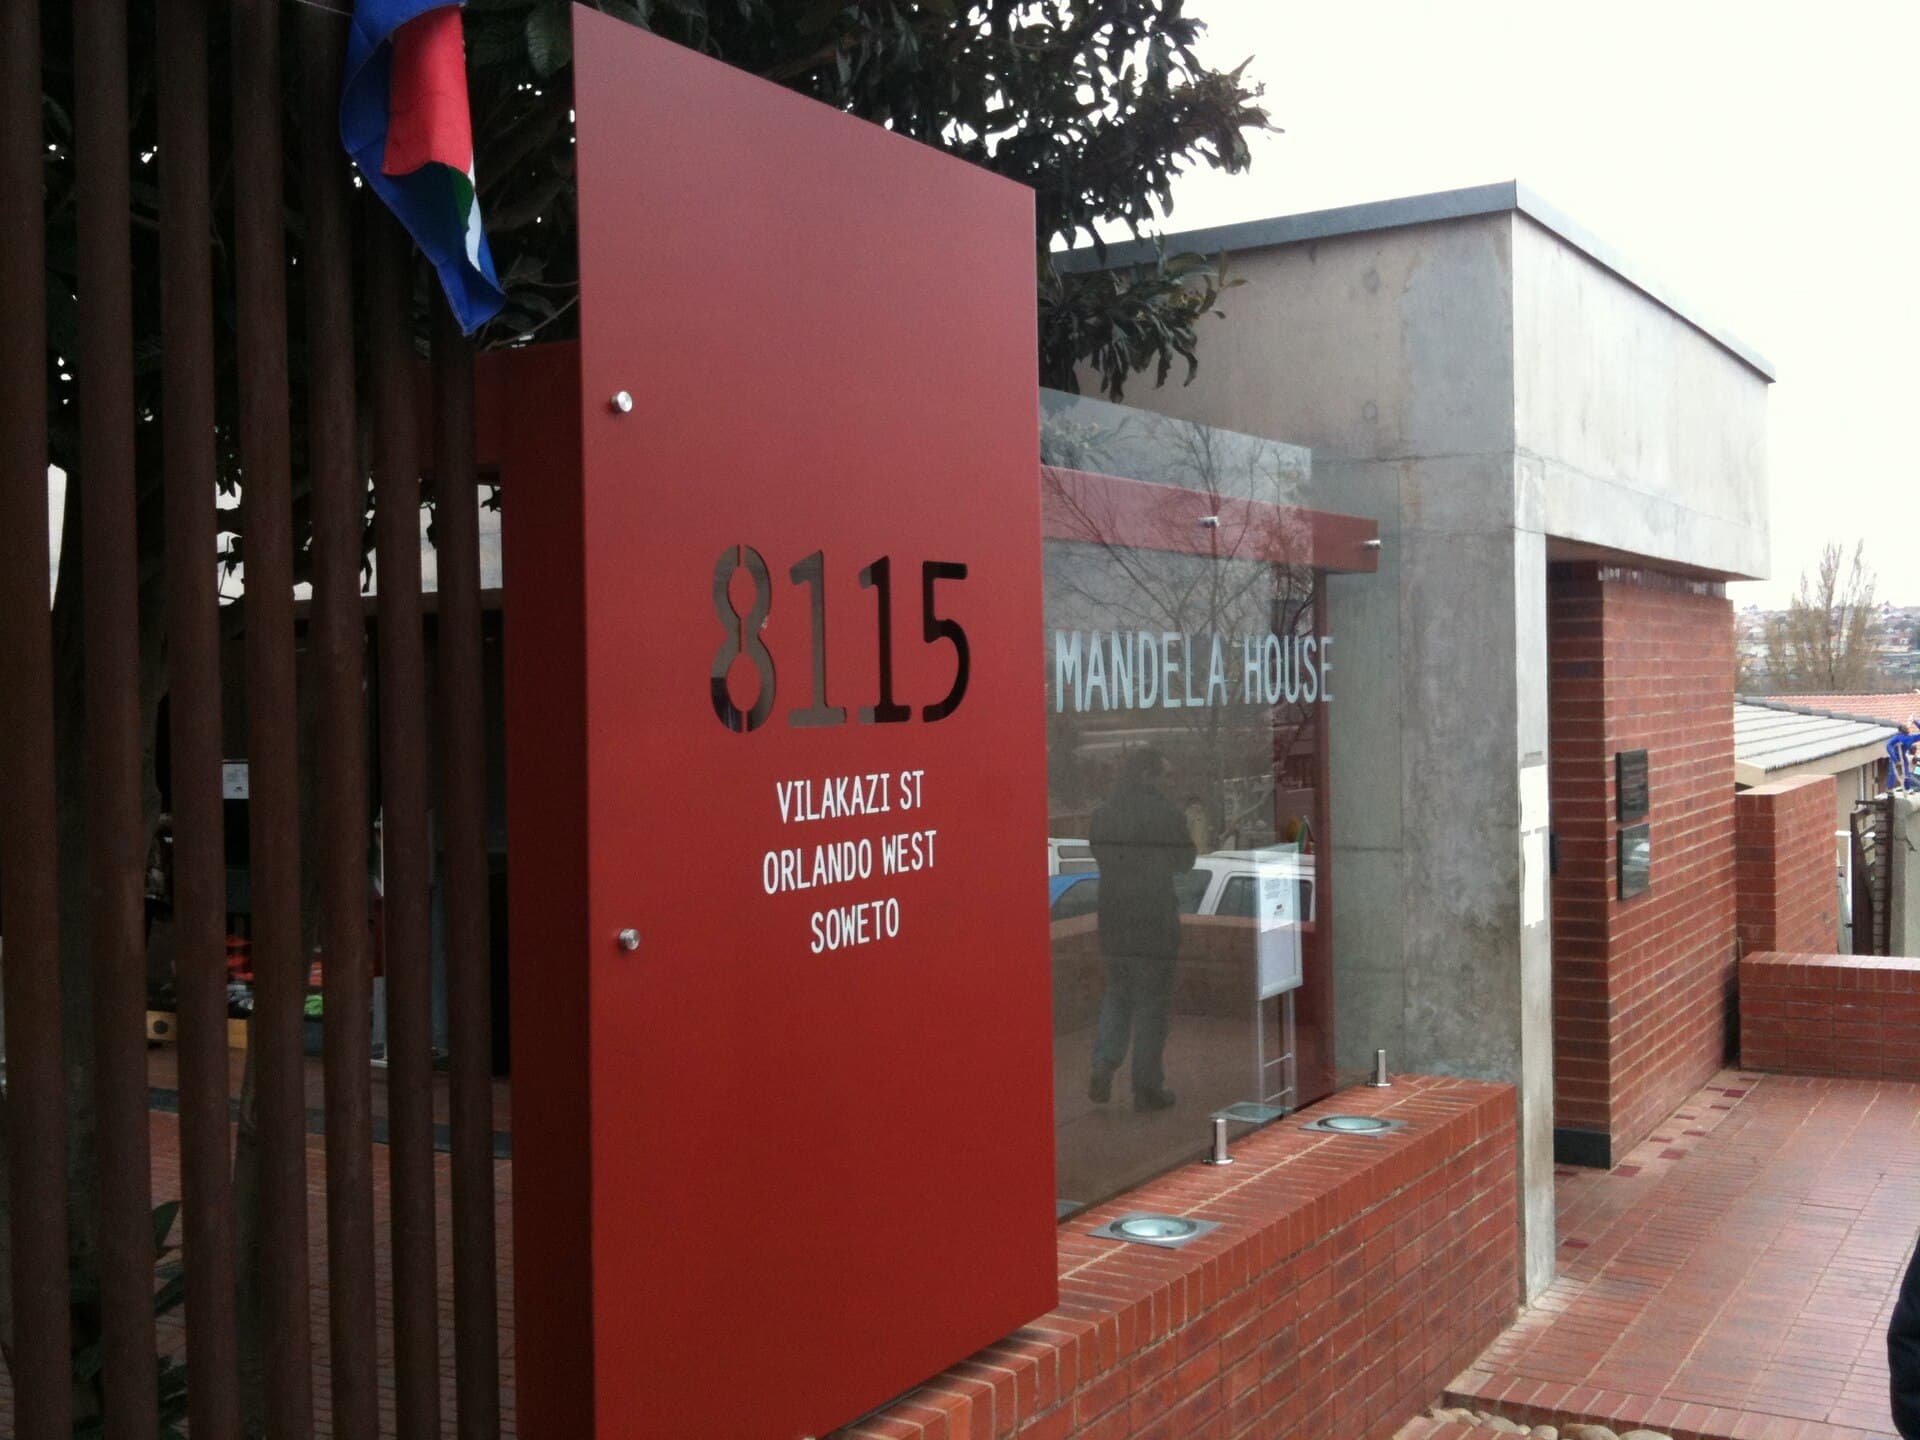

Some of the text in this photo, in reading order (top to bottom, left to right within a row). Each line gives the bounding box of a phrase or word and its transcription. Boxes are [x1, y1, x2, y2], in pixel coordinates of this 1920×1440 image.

[710, 544, 970, 734] 8115
[1055, 630, 1336, 713] MANDELA HOUSE
[776, 770, 925, 824] VILAKAZI ST
[762, 830, 937, 895] ORLANDO WEST
[810, 897, 900, 954] SOWETO
